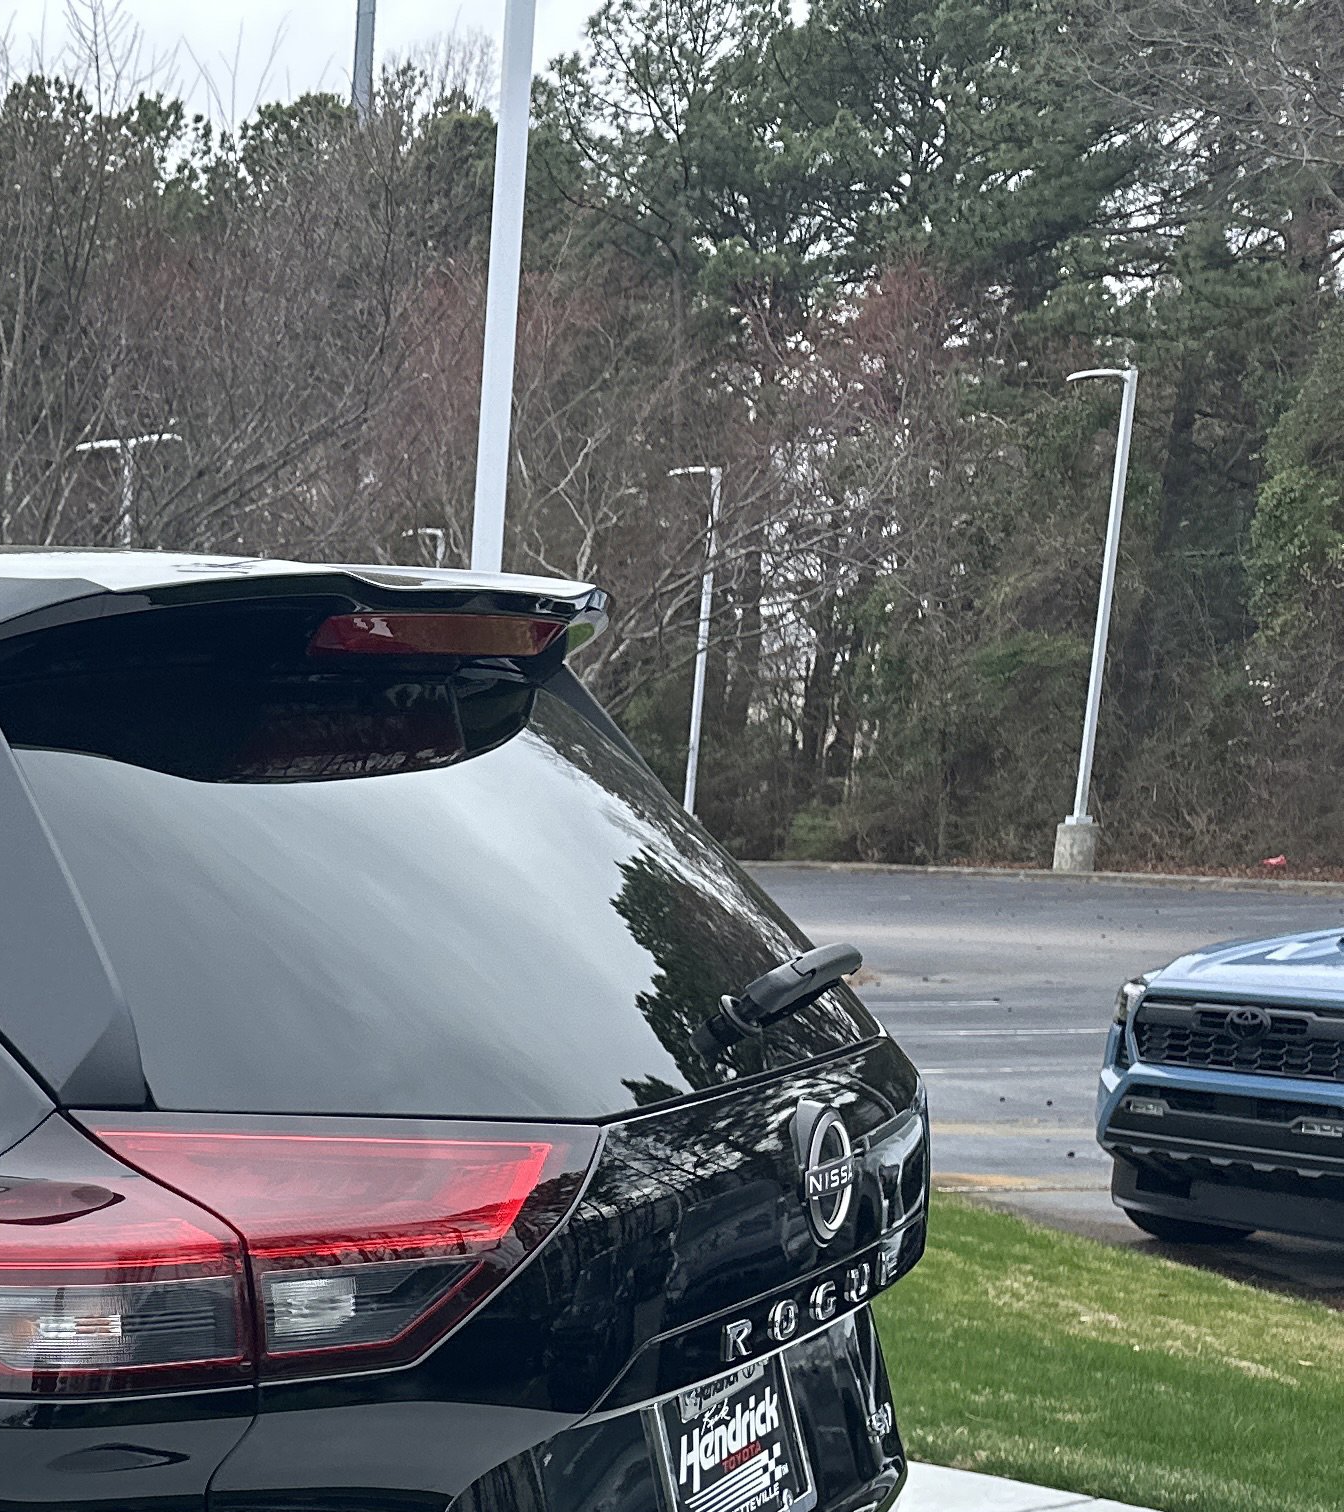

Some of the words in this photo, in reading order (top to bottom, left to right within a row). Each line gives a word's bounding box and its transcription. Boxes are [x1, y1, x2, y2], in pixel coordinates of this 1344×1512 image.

[720, 1250, 898, 1362] ROGUE
[679, 1386, 779, 1494] Hendrick
[721, 1441, 762, 1473] TOYOTA
